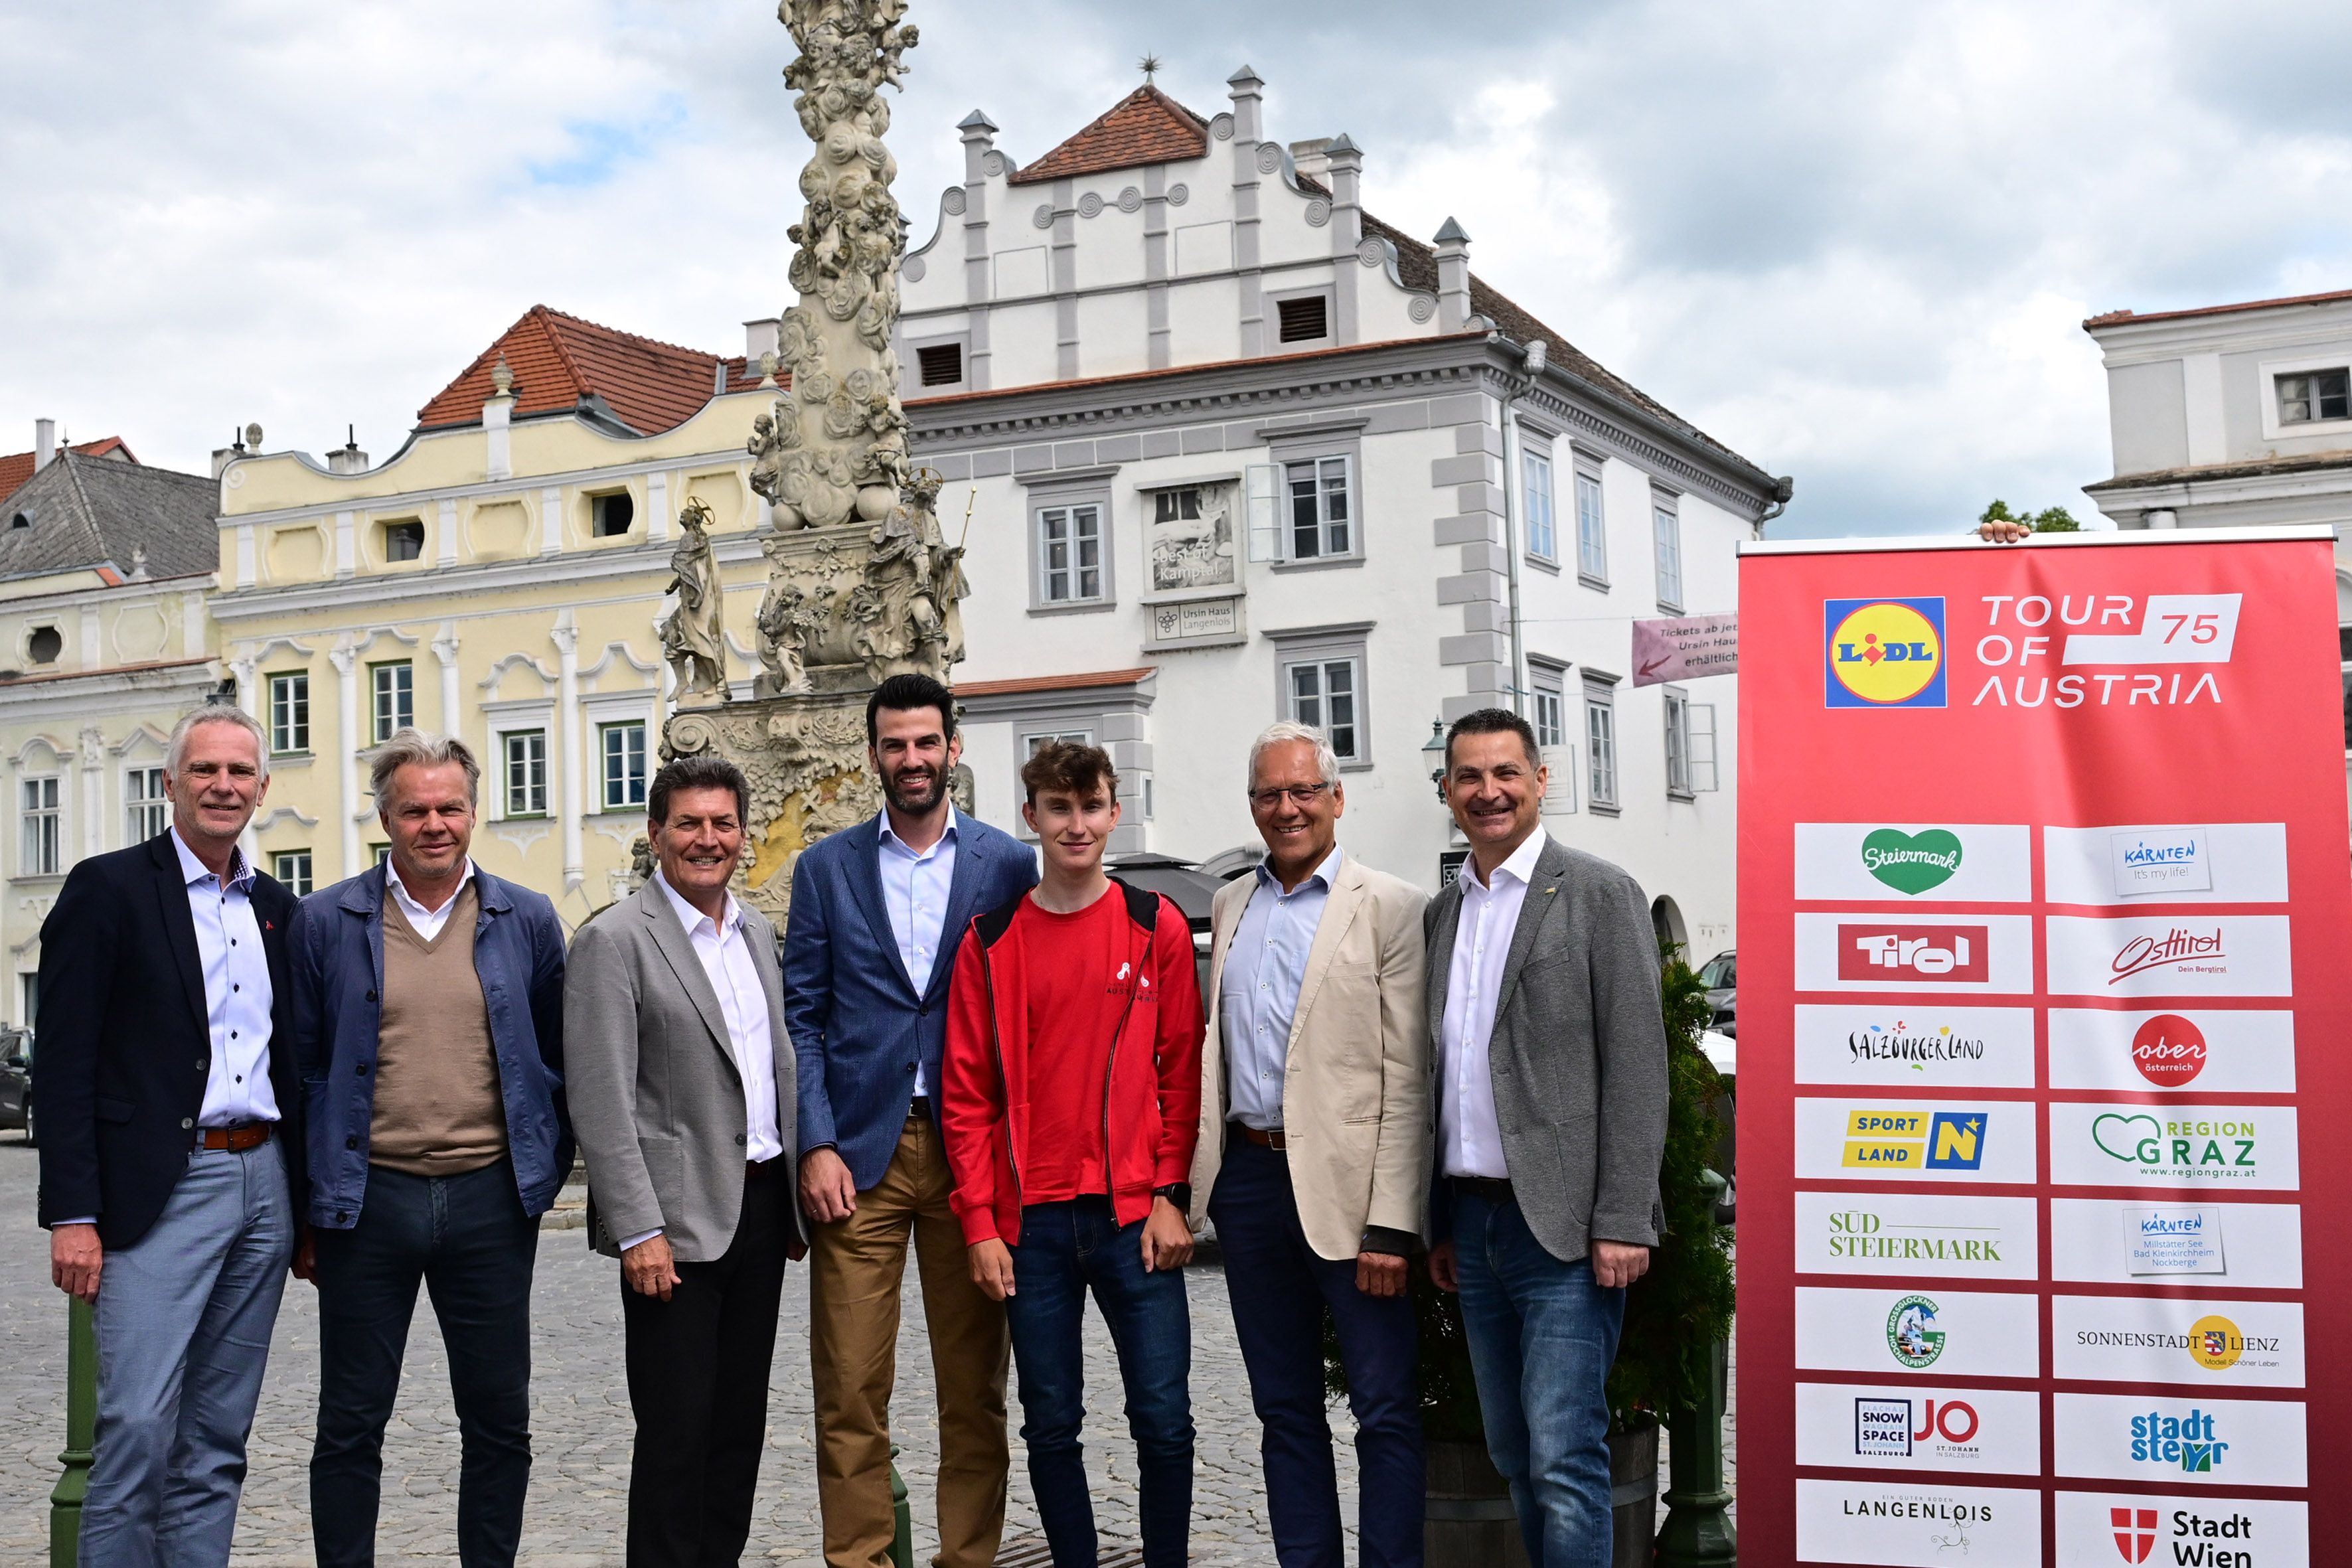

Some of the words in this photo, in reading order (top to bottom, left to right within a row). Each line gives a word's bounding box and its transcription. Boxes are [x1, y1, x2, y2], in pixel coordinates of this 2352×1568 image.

[1194, 546, 1208, 558] of
[1160, 562, 1222, 582] Kamptal.
[1183, 609, 1207, 618] Ursin
[1208, 607, 1230, 615] Haus
[1981, 595, 2134, 625] TOUR
[2161, 615, 2219, 644] 75
[1184, 617, 1231, 630] Langenlois
[1660, 628, 1700, 637] Tickets
[1721, 623, 1738, 634] jet
[1679, 641, 1709, 650] Ursin
[1976, 635, 2050, 666] OF
[1686, 652, 1738, 666] erhältlich
[1972, 673, 2221, 708] AUSTRIA
[1865, 848, 1958, 872] Steiermark
[2125, 839, 2195, 863] KÄRNTEN
[2151, 869, 2167, 880] my
[2170, 867, 2189, 877] life!
[1857, 934, 1970, 974] Tirol
[2112, 927, 2221, 973] Osttirol
[2132, 1036, 2207, 1059] ober
[2146, 1063, 2193, 1071] österreich
[1857, 1117, 1919, 1131] SPORT
[2167, 1122, 2254, 1137] REGION
[1934, 1121, 1977, 1160] N
[1858, 1148, 1909, 1161] LAND
[2136, 1138, 2255, 1166] GRAZ
[2140, 1168, 2256, 1178] www.regiongraz.at
[2142, 1213, 2202, 1232] KÄRNTEN
[1830, 1236, 2001, 1261] STEIERMARK
[2152, 1249, 2215, 1257] Kleinkirchheim
[2152, 1259, 2197, 1267] Nockberge
[1889, 1296, 1937, 1332] GROSSGLOCKNER
[1889, 1334, 1944, 1366] HOCHALPENSTRASSE
[2077, 1332, 2201, 1349] SONNENSTADT
[2231, 1337, 2279, 1352] LIENZ
[2229, 1358, 2256, 1367] Schöner
[1863, 1412, 1904, 1423] SNOW
[1914, 1399, 1979, 1443] JO
[2131, 1409, 2216, 1441] stadt
[1863, 1430, 1904, 1442] SPACE
[2132, 1439, 2229, 1472] steyr
[1844, 1500, 1992, 1522] LANGENLOIS
[2173, 1511, 2252, 1539] Stadt
[2173, 1541, 2252, 1568] Wien
